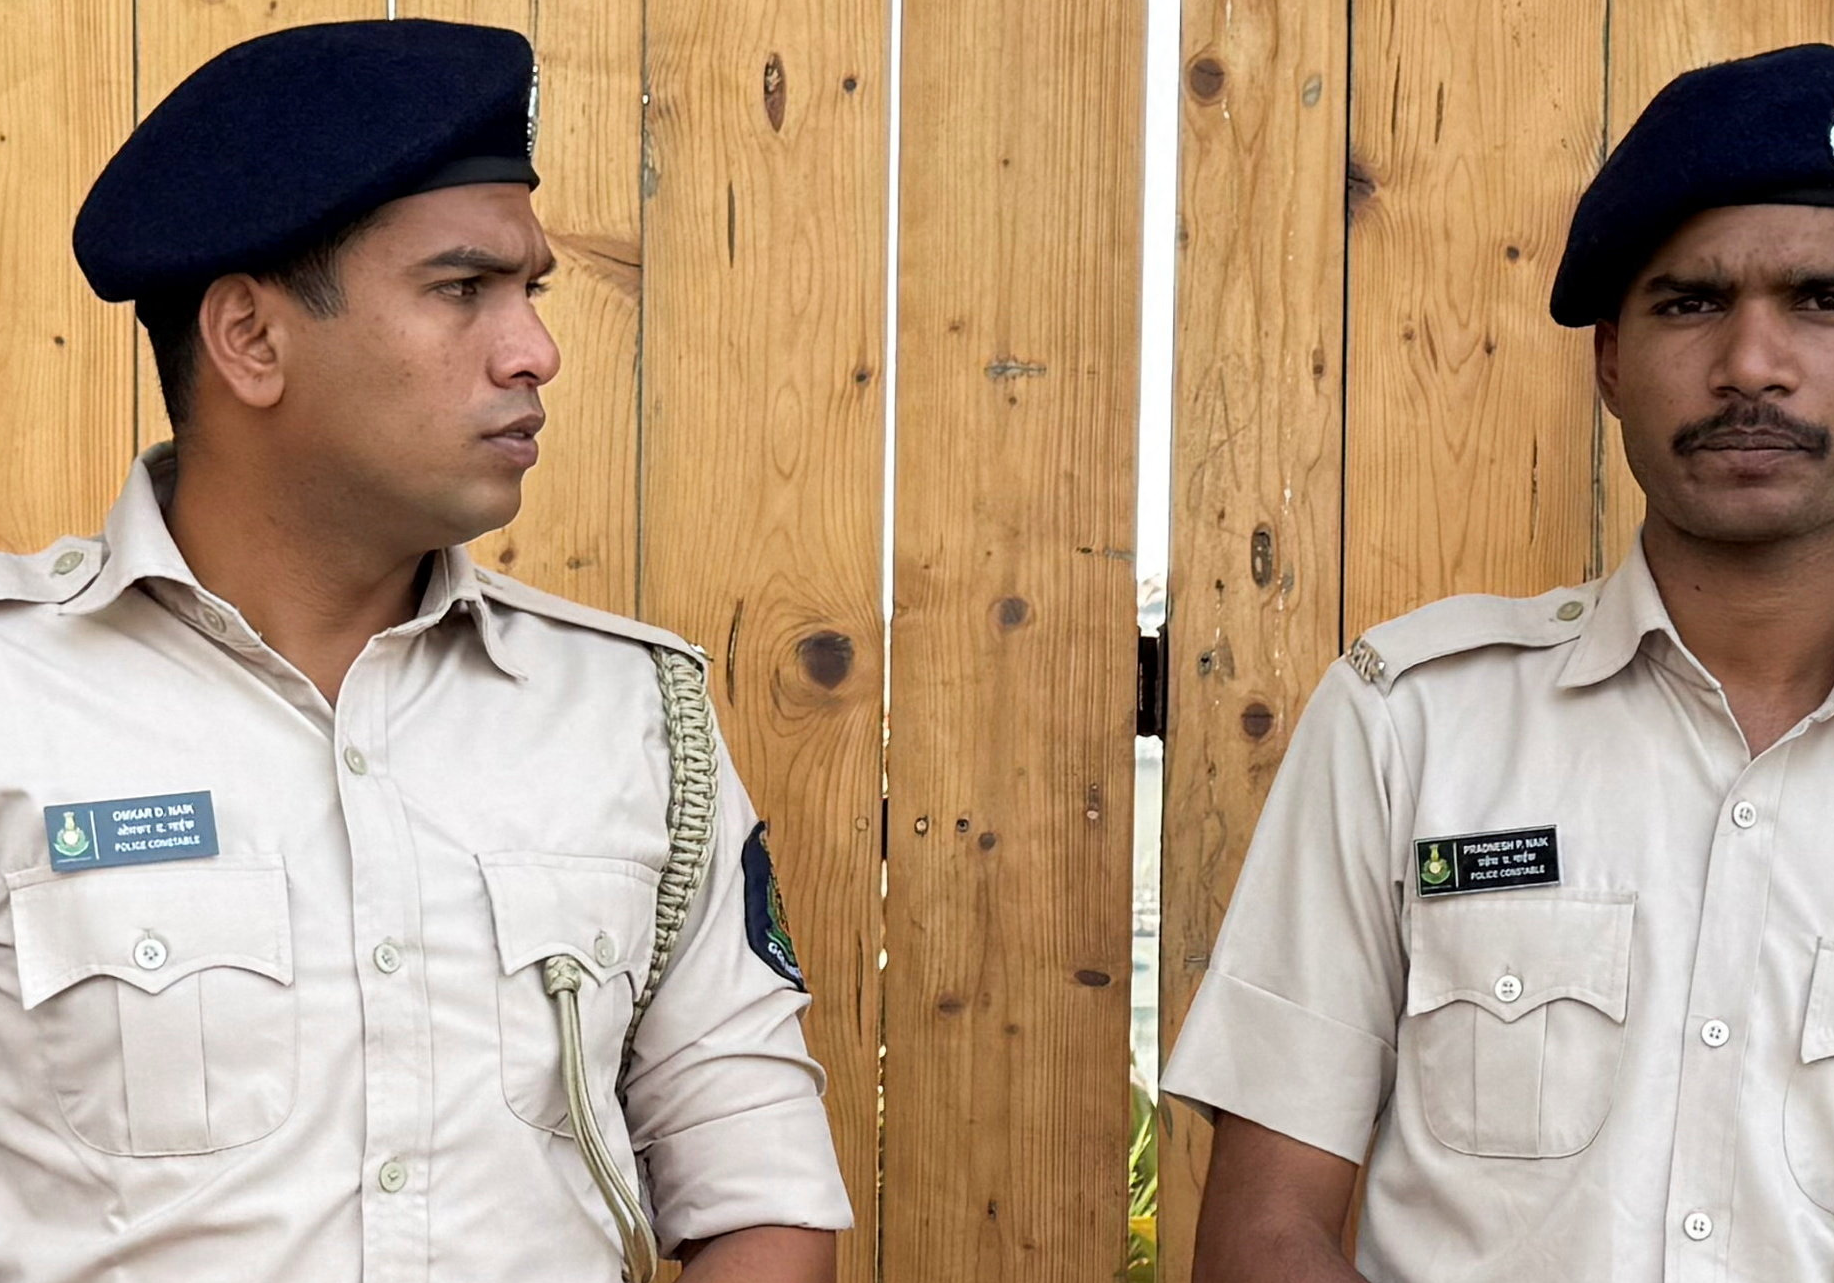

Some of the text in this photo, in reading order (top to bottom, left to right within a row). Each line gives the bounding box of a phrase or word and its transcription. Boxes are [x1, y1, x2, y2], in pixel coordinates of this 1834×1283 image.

[114, 835, 201, 853] POLICE CONSTABLE
[1470, 864, 1546, 880] POLICE CONSTABLE
